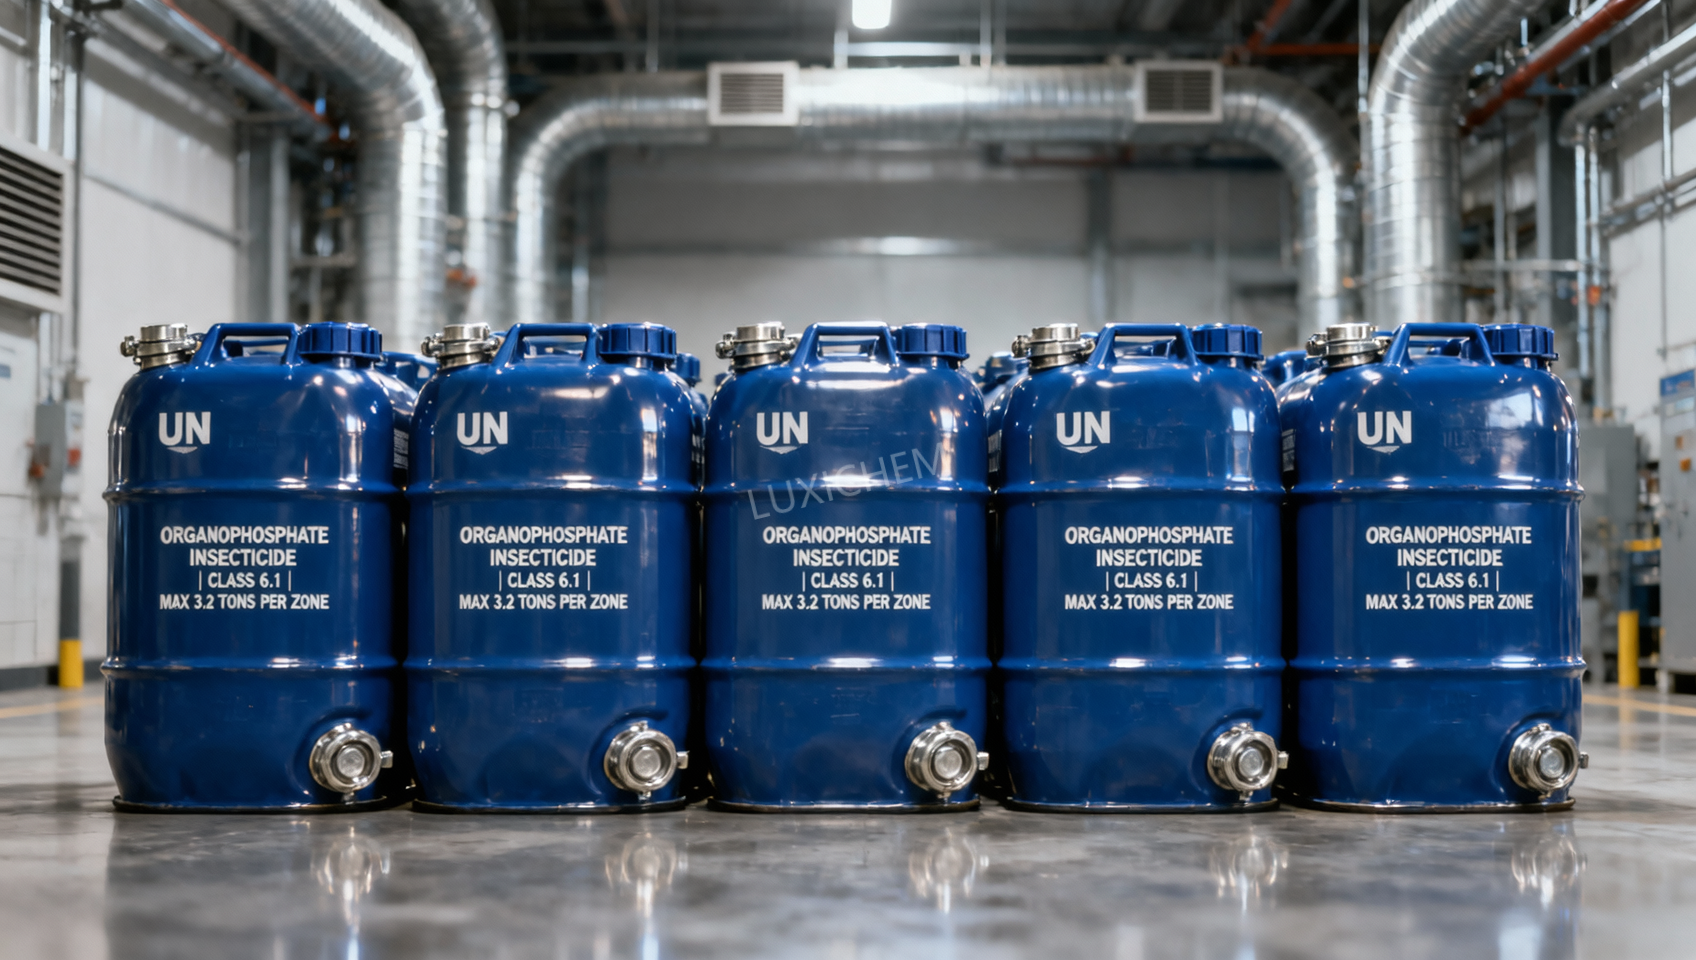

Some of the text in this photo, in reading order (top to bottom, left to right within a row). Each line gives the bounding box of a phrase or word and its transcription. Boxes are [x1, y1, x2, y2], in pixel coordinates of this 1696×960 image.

[158, 411, 211, 446] UN
[456, 411, 508, 446] UN
[756, 411, 809, 446] UN
[1056, 411, 1111, 446] UN
[1356, 411, 1412, 446] UN
[160, 525, 330, 545] ORGANOPHOSPHATE
[459, 525, 629, 545] ORGANOPHOSPHATE
[762, 525, 932, 545] ORGANOPHOSPHATE
[1064, 525, 1234, 545] ORGANOPHOSPHATE
[1365, 525, 1532, 545] ORGANOPHOSPHATE
[189, 548, 297, 567] INSECTICIDE
[490, 548, 597, 567] INSECTICIDE
[793, 548, 900, 567] INSECTICIDE
[1096, 548, 1203, 567] INSECTICIDE
[1397, 548, 1504, 567] INSECTICIDE
[207, 572, 256, 588] CLASS
[259, 572, 280, 588] 6.1
[507, 572, 556, 588] CLASS
[558, 572, 580, 588] 6.1
[810, 572, 859, 588] CLASS
[862, 572, 884, 588] 6.1
[1114, 572, 1163, 588] CLASS
[1165, 572, 1187, 588] 6.1
[1415, 572, 1465, 588] CLASS
[1467, 572, 1489, 588] 6.1
[159, 593, 330, 610] MAX 3.2 TONS PER ZONE
[459, 593, 629, 610] MAX 3.2 TONS PER ZONE
[761, 593, 931, 610] MAX 3.2 TONS PER ZONE
[1064, 593, 1235, 610] MAX 3.2 TONS PER ZONE
[1365, 593, 1534, 610] MAX 3.2 TONS PER ZONE
